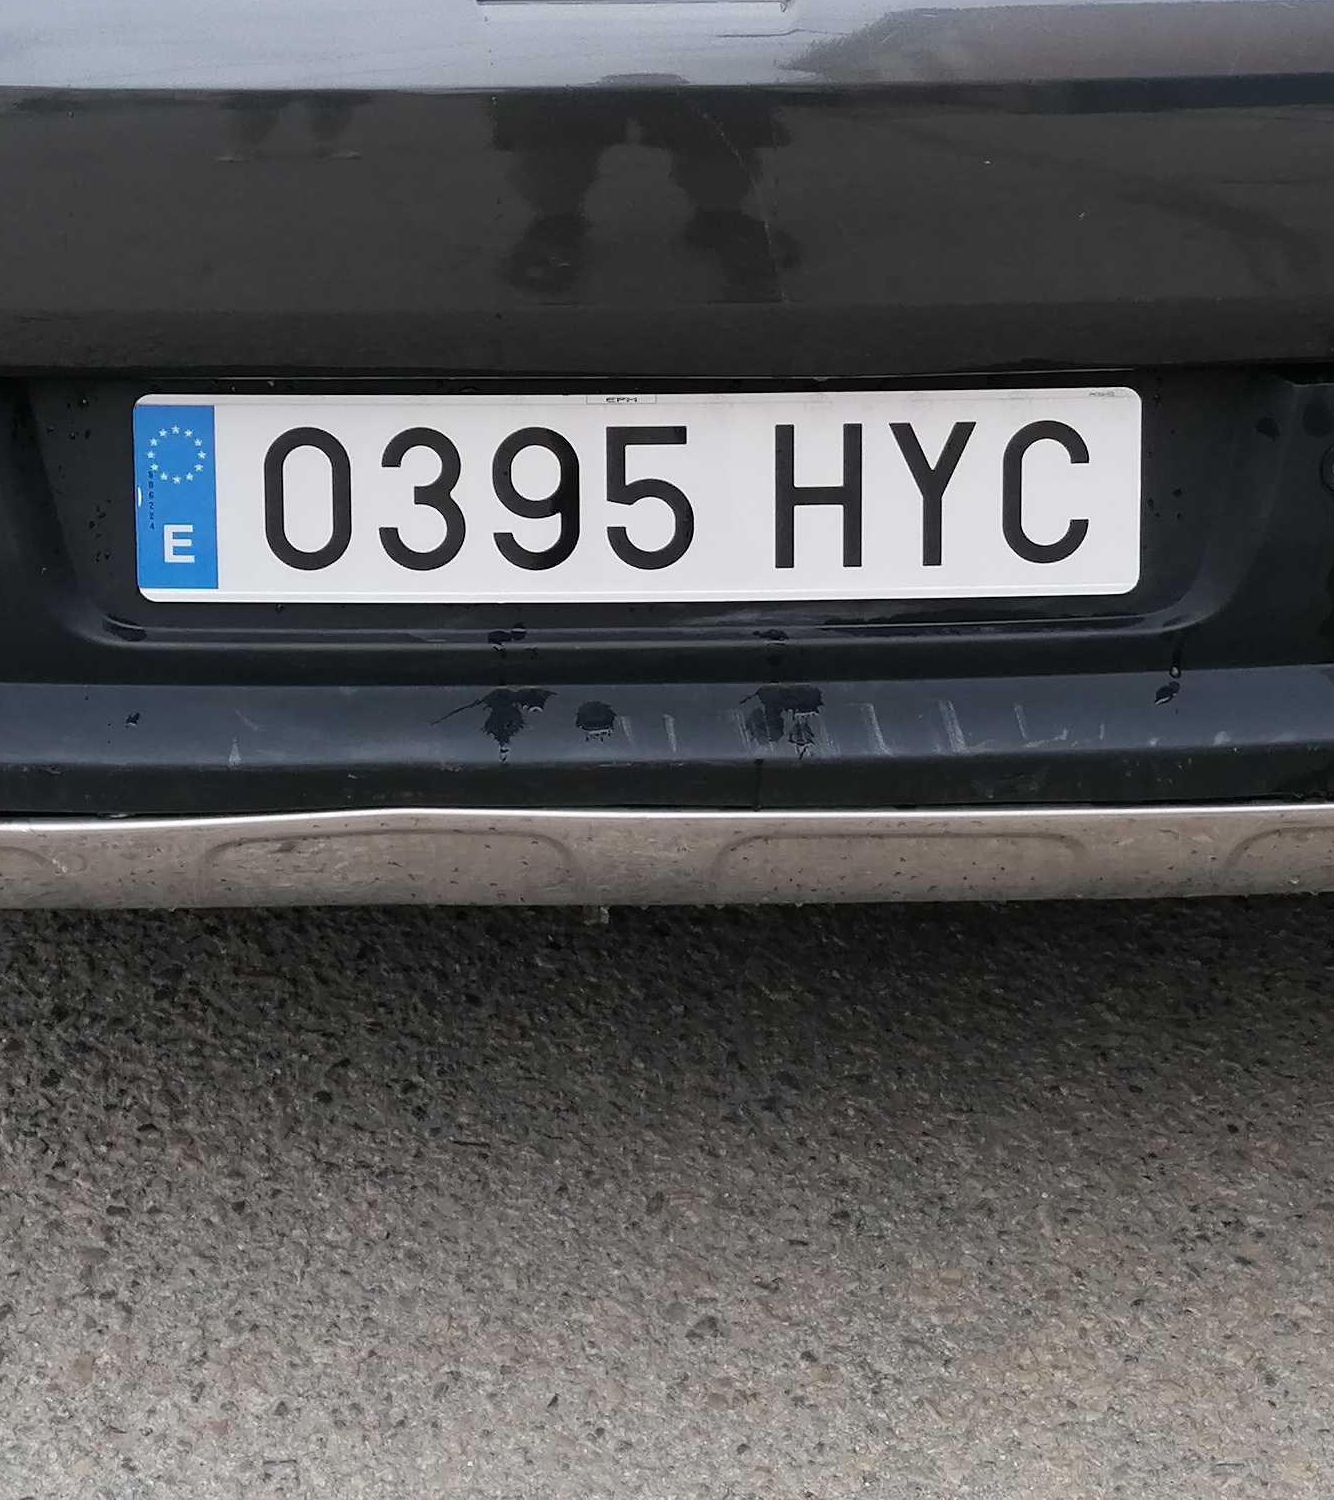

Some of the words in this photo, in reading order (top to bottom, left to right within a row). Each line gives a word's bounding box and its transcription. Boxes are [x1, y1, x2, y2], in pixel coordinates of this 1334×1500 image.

[264, 426, 695, 572] 0395
[774, 419, 1091, 569] HYC
[164, 524, 195, 564] E
